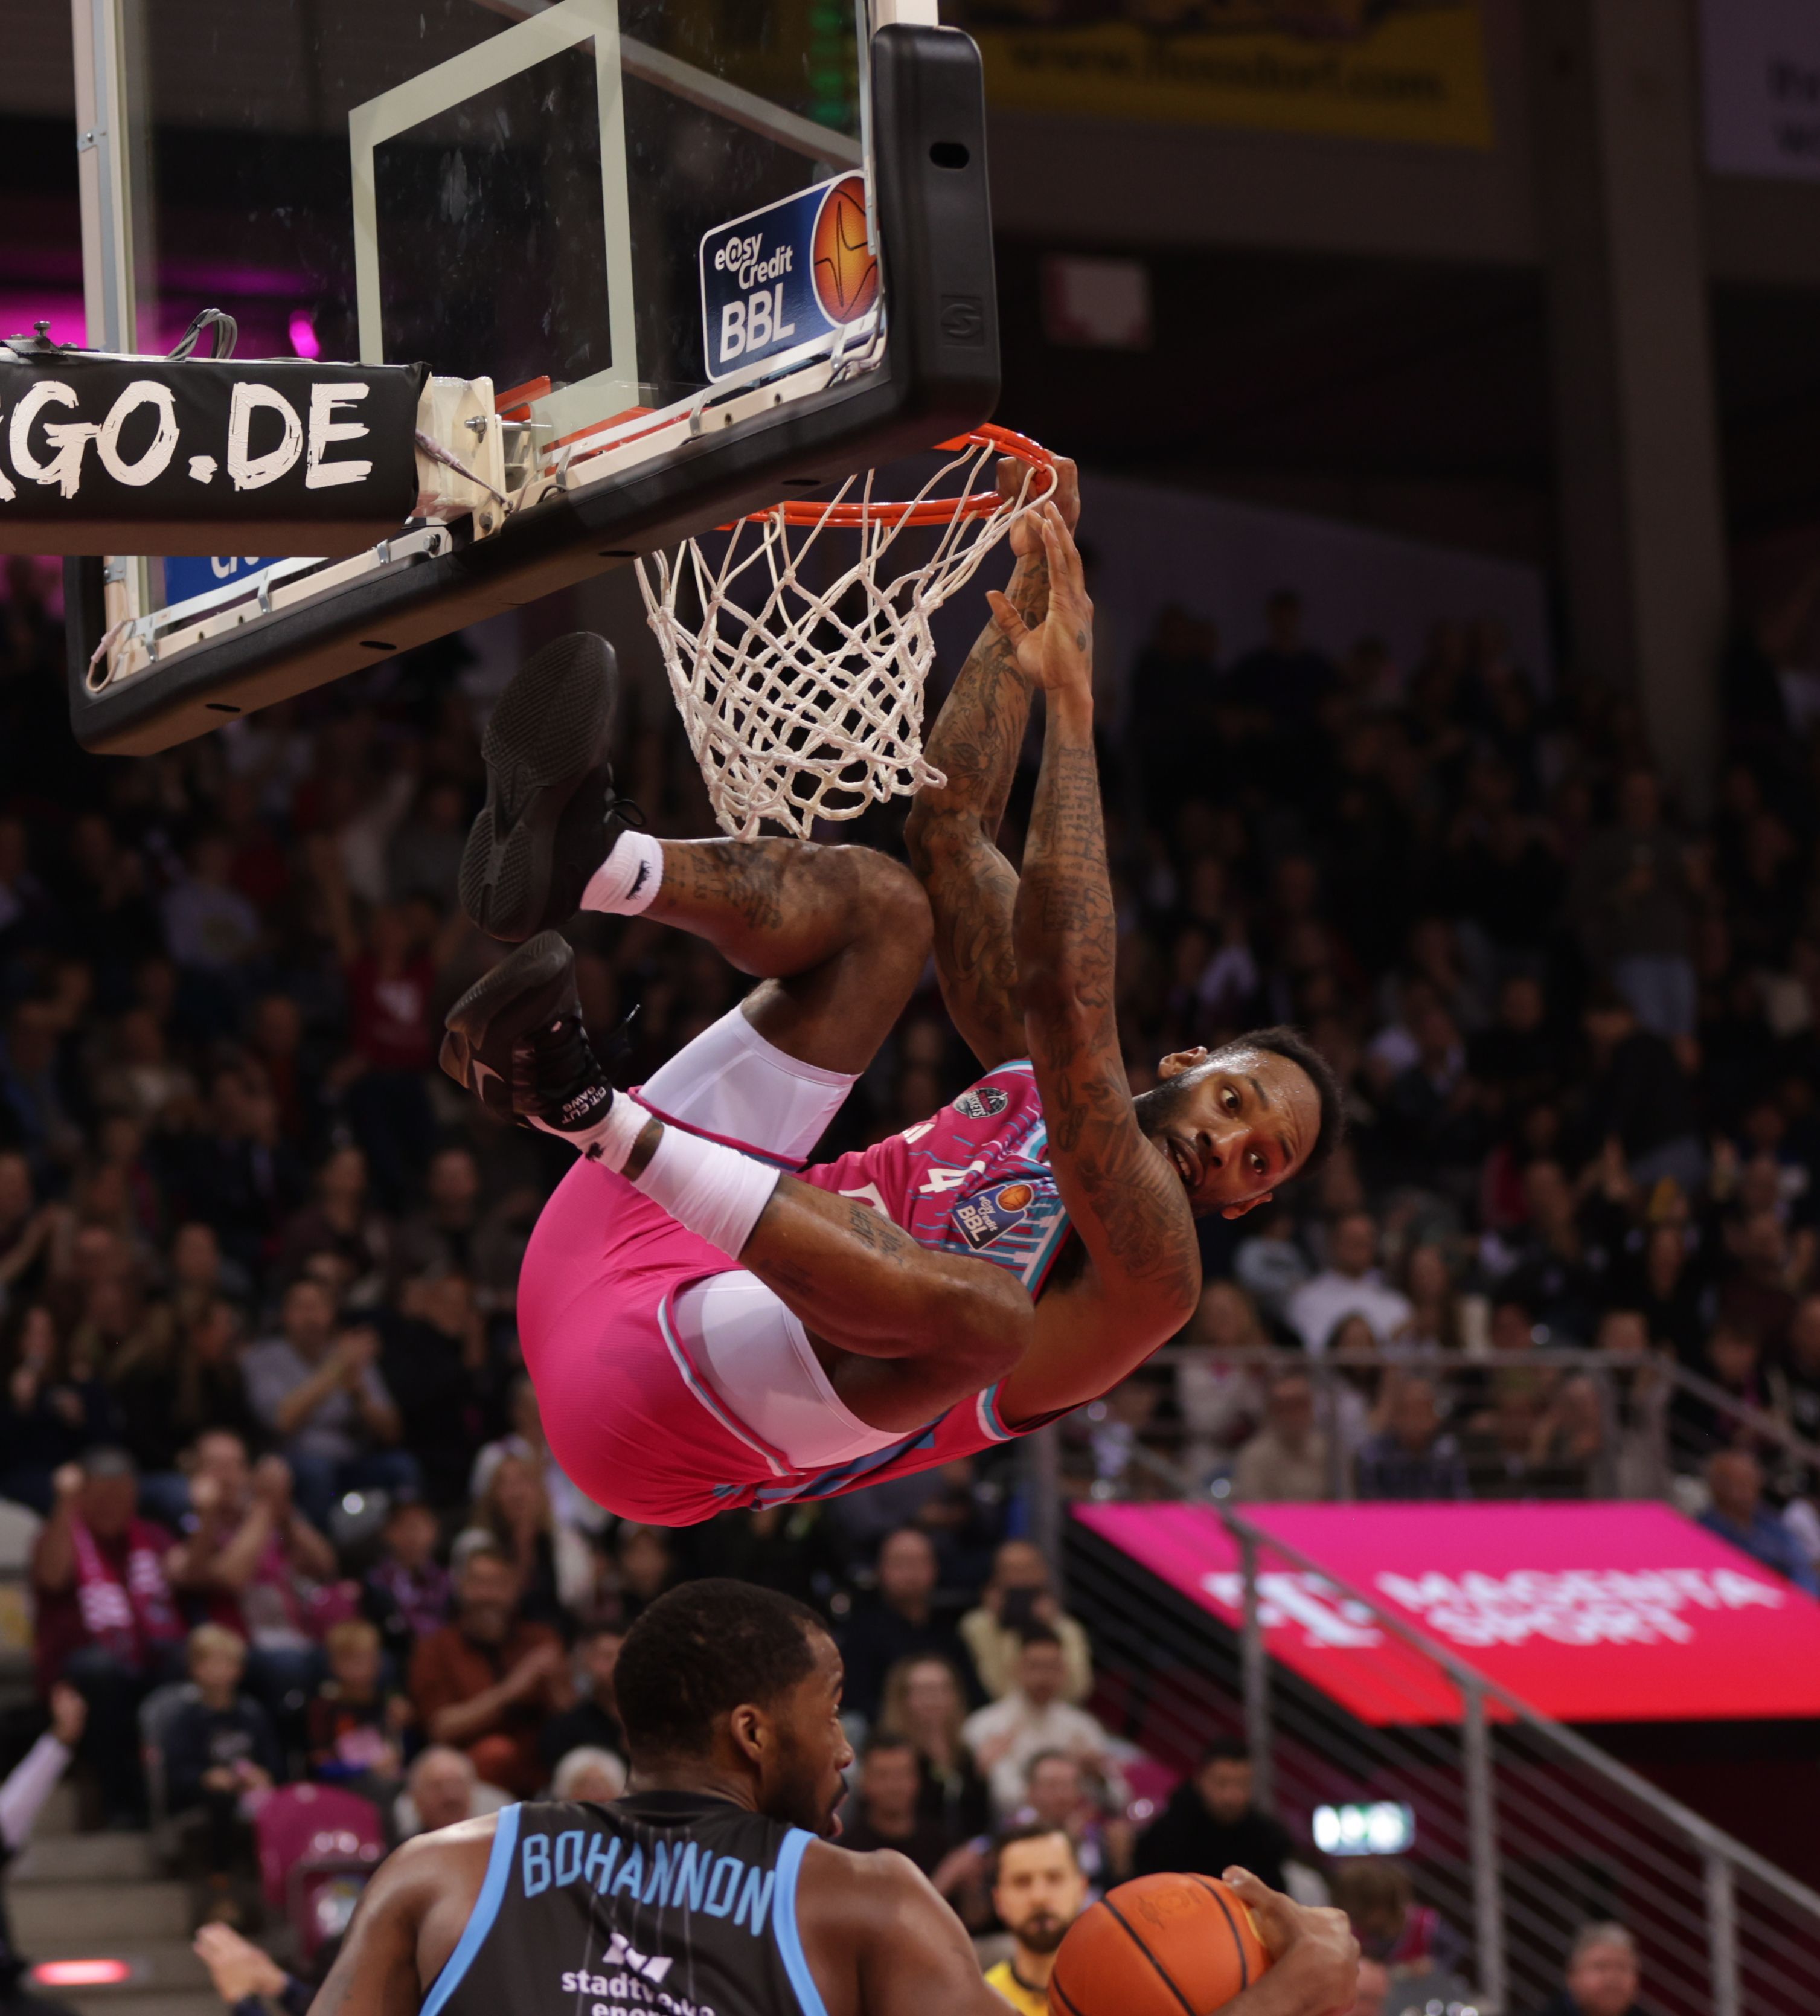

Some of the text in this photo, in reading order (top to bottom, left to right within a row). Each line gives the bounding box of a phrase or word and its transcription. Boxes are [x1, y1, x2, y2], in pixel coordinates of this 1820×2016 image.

[738, 245, 793, 290] Credit
[719, 282, 795, 364] BBL
[0, 380, 373, 502] GO.DE
[956, 1205, 988, 1242] BBL
[1427, 1604, 1693, 1647] SPORT
[523, 1829, 775, 1937] BOHANNON
